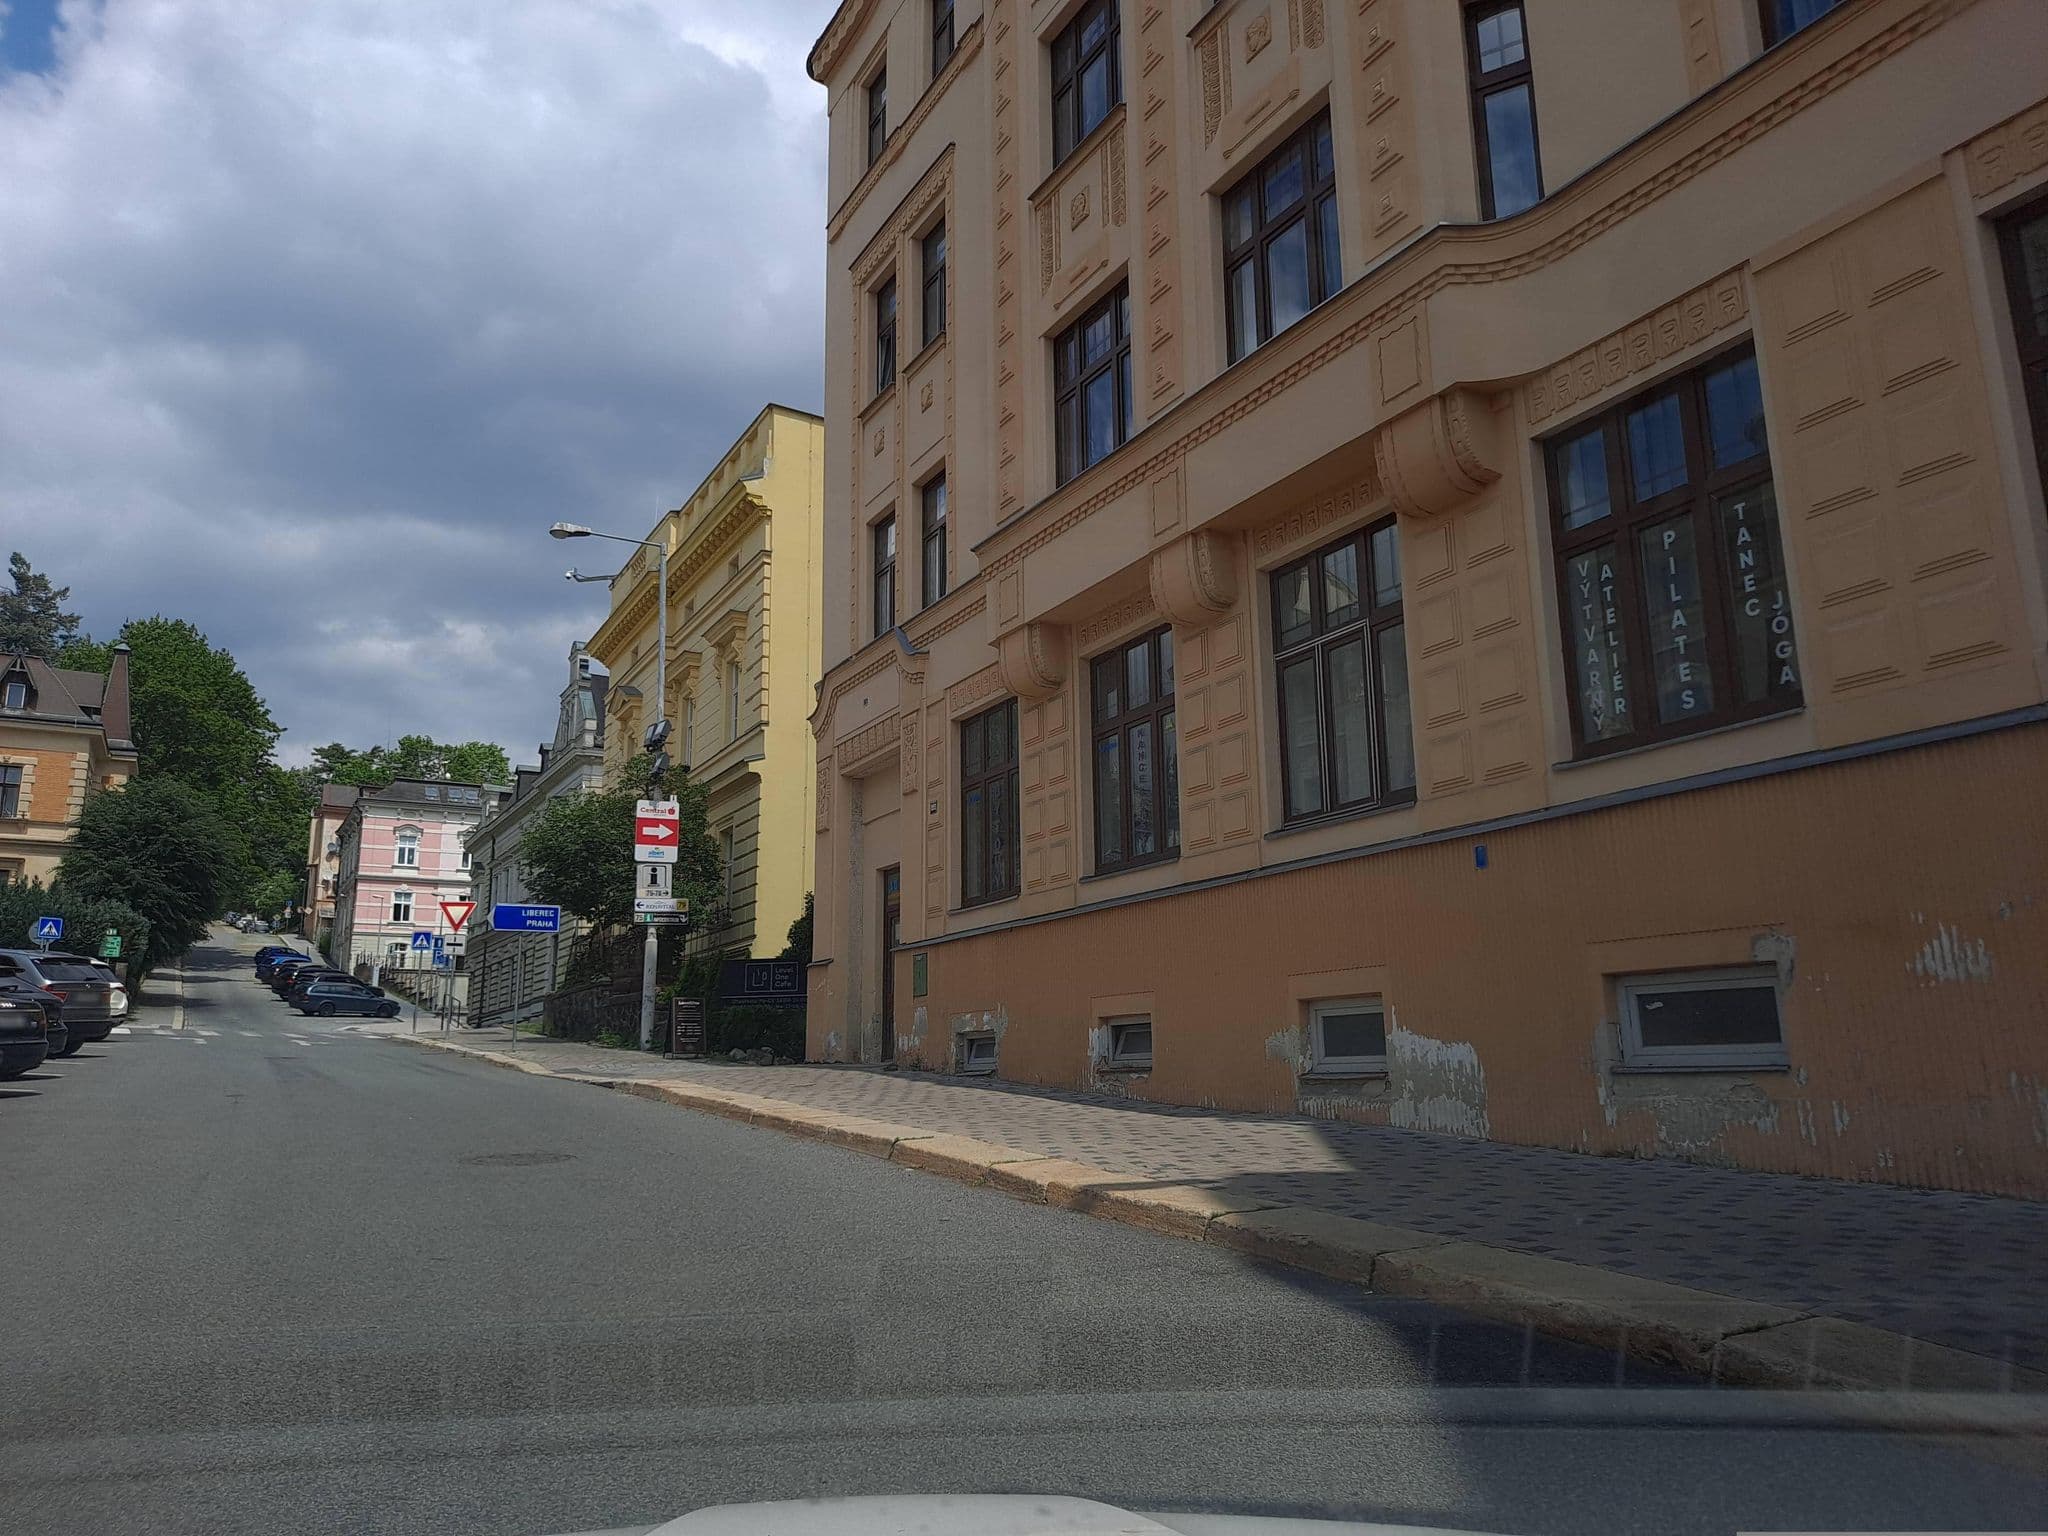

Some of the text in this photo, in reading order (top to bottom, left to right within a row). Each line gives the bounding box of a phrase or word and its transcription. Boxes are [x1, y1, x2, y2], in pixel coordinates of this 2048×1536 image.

[1733, 502, 1761, 617] TANEC
[1599, 563, 1627, 715] ATELIÉR
[1662, 530, 1695, 711] PILATES
[1770, 590, 1796, 685] JÓGA
[640, 806, 667, 814] Central
[521, 908, 555, 917] LIBEREC
[526, 919, 554, 928] PRAHA
